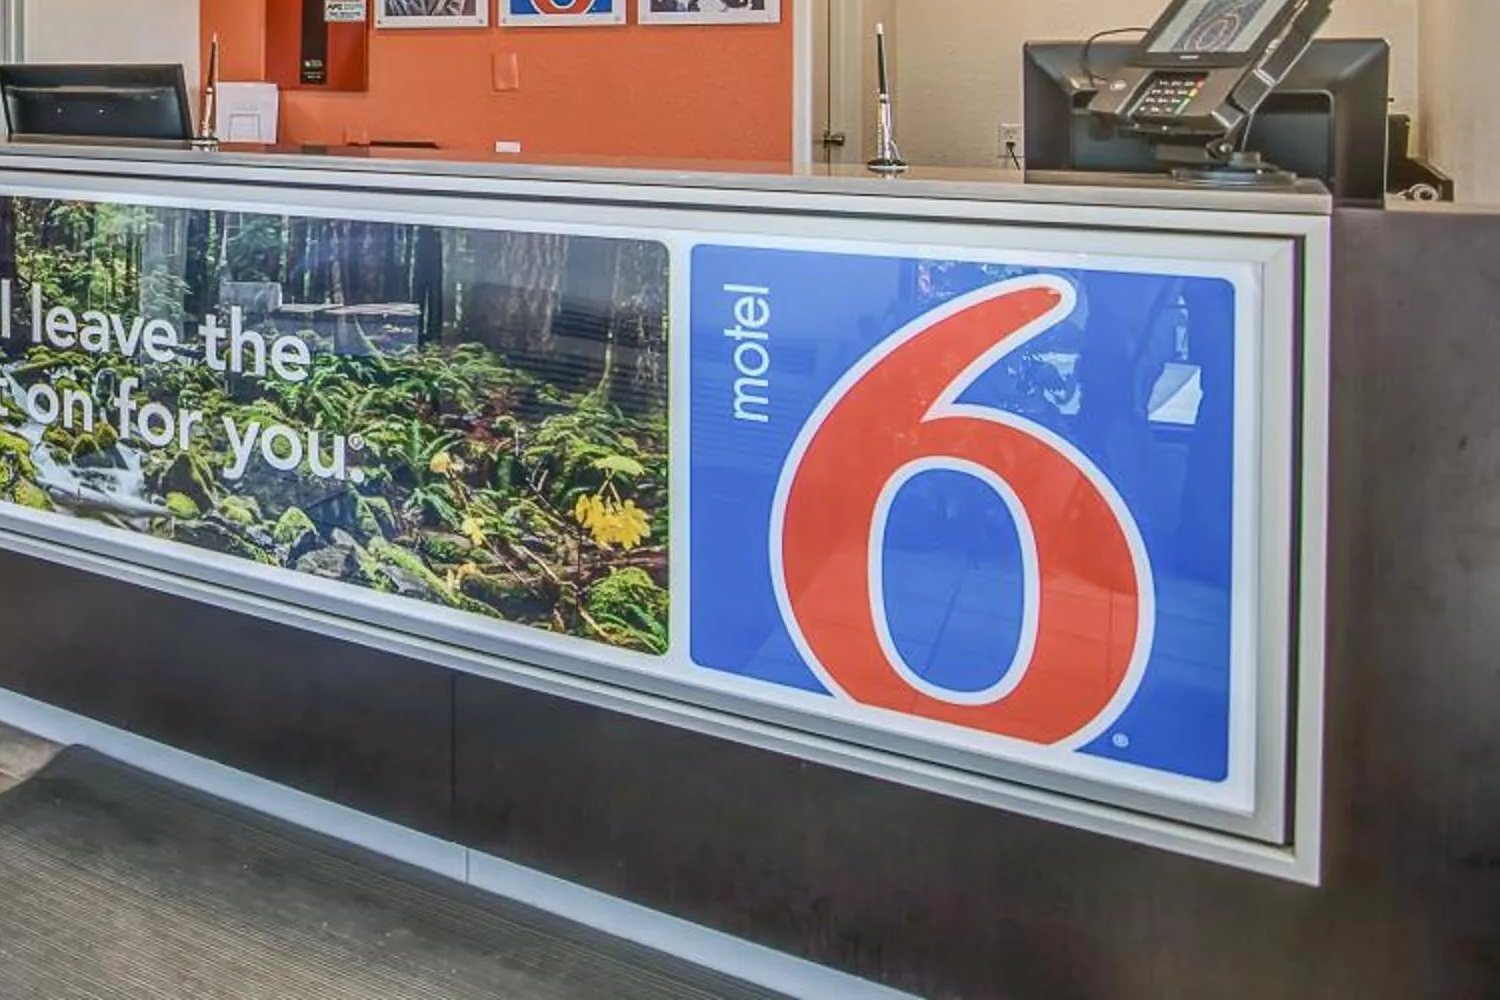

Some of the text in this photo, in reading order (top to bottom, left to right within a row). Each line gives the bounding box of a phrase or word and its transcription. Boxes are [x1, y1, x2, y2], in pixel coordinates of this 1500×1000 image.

[32, 284, 178, 362] leave
[199, 306, 312, 381] the
[724, 283, 769, 423] motel
[28, 383, 93, 433] on
[113, 376, 201, 450] for
[769, 273, 1156, 752] 6
